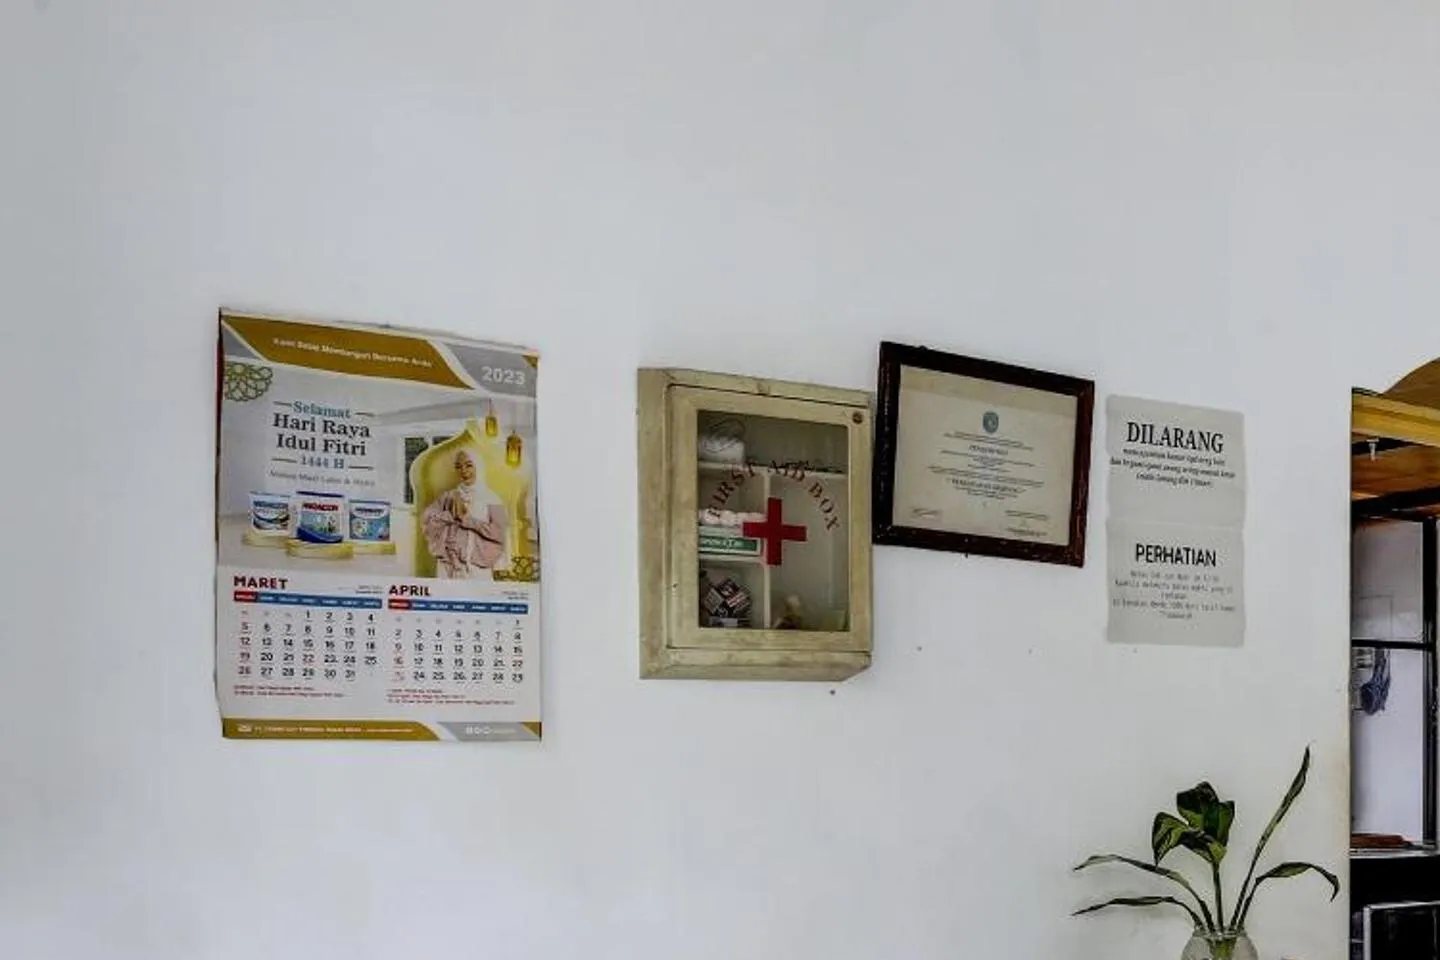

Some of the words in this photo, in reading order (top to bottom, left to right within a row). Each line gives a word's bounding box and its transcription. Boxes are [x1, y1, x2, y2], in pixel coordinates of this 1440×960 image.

[481, 365, 526, 385] 2023
[293, 400, 351, 419] Selamat
[272, 412, 316, 432] Hari
[322, 420, 371, 439] Raya
[276, 433, 316, 452] Idul
[322, 439, 366, 456] Fitri
[1127, 422, 1224, 454] DILARANG
[301, 454, 329, 468] 1444
[333, 458, 345, 469] H
[707, 457, 756, 518] FIRST
[767, 459, 810, 481] AID
[808, 481, 840, 531] BOX
[1135, 543, 1217, 568] PERHATIAN
[233, 575, 288, 589] MARET
[389, 585, 431, 596] APRIL
[306, 610, 310, 619] 1
[346, 612, 353, 621] 3
[368, 613, 374, 621] 4
[264, 623, 271, 632] 6
[285, 624, 291, 632] 7
[305, 625, 311, 633] 8
[326, 626, 333, 634] 9
[344, 627, 354, 636] 10
[367, 627, 375, 636] 11
[241, 637, 250, 645] 12
[262, 637, 272, 646] 13
[303, 639, 313, 647] 15
[325, 641, 335, 649] 16
[345, 641, 354, 649] 17
[366, 642, 375, 650] 18
[261, 653, 273, 661] 20
[283, 653, 294, 661] 21
[302, 654, 314, 663] 22
[324, 655, 336, 663] 23
[343, 655, 356, 663] 24
[364, 656, 377, 665] 25
[239, 666, 250, 675] 26
[261, 667, 273, 675] 27
[282, 668, 294, 676] 28
[324, 669, 336, 679] 30
[345, 670, 356, 679] 31
